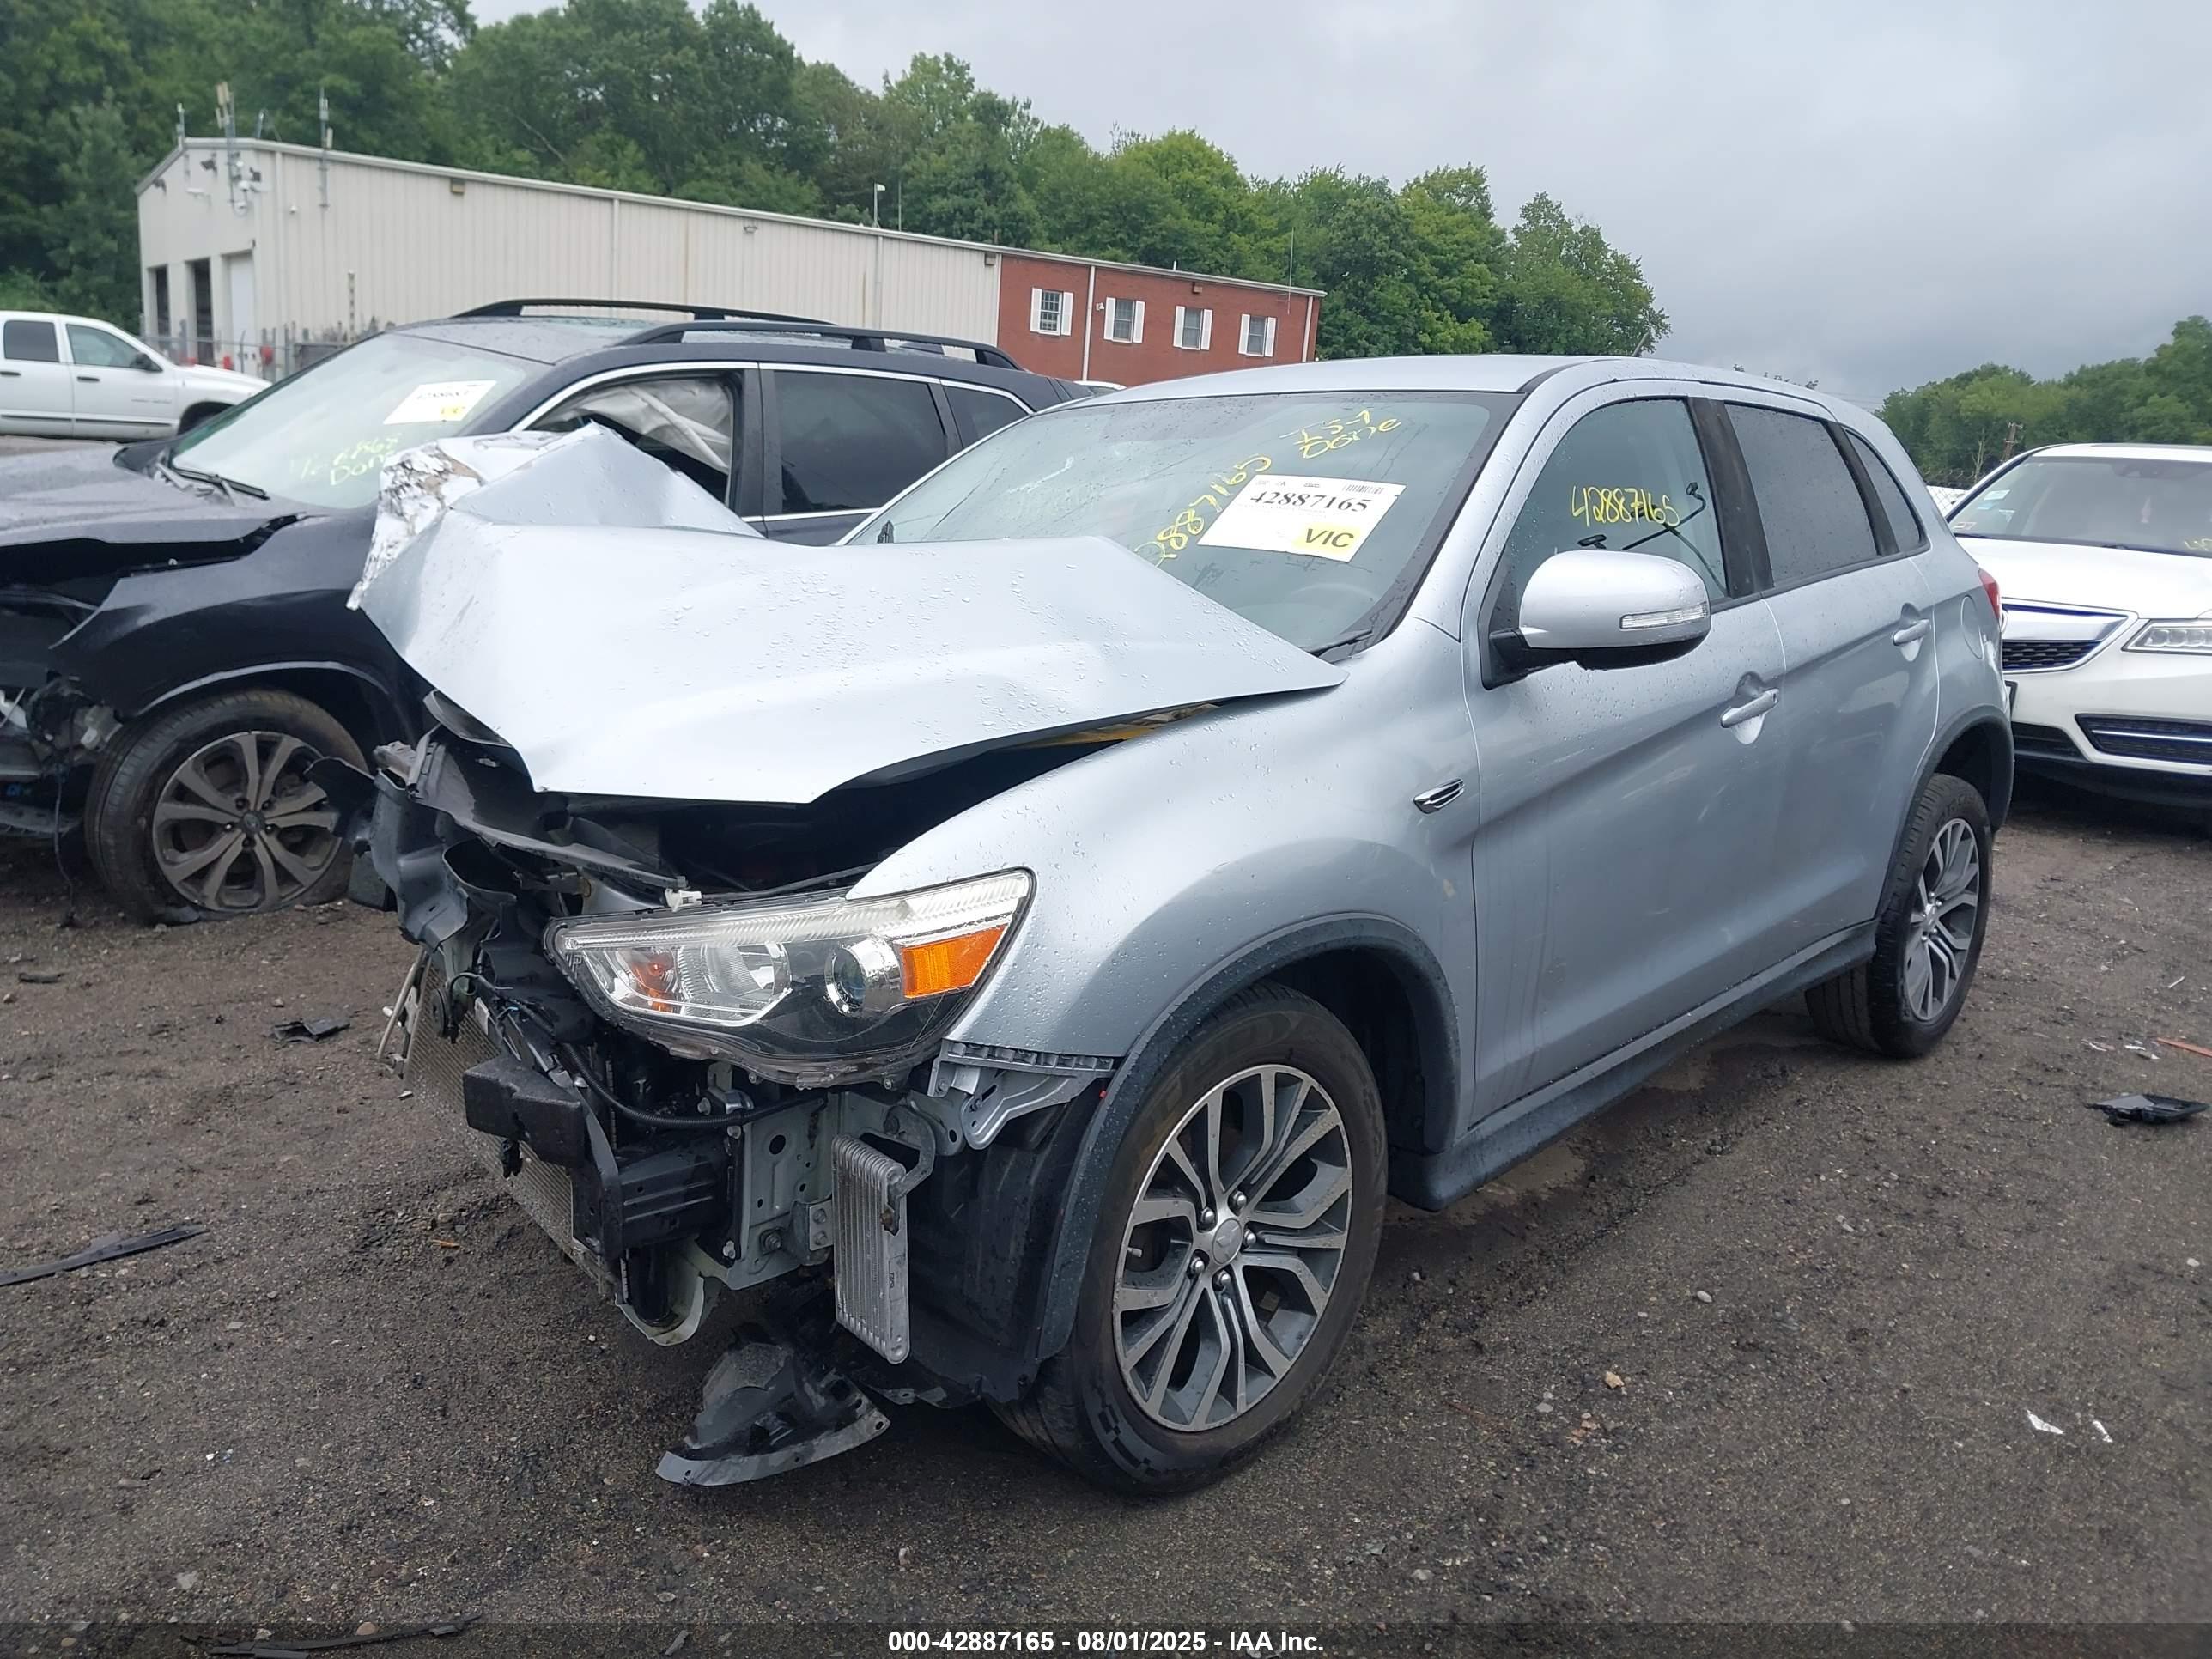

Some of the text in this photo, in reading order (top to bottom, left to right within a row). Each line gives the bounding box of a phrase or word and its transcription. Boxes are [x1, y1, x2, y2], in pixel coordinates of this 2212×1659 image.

[1299, 418, 1402, 459] Done
[1250, 490, 1372, 513] 42887165
[1571, 485, 1680, 527] 42887165
[1304, 527, 1355, 548] VIC
